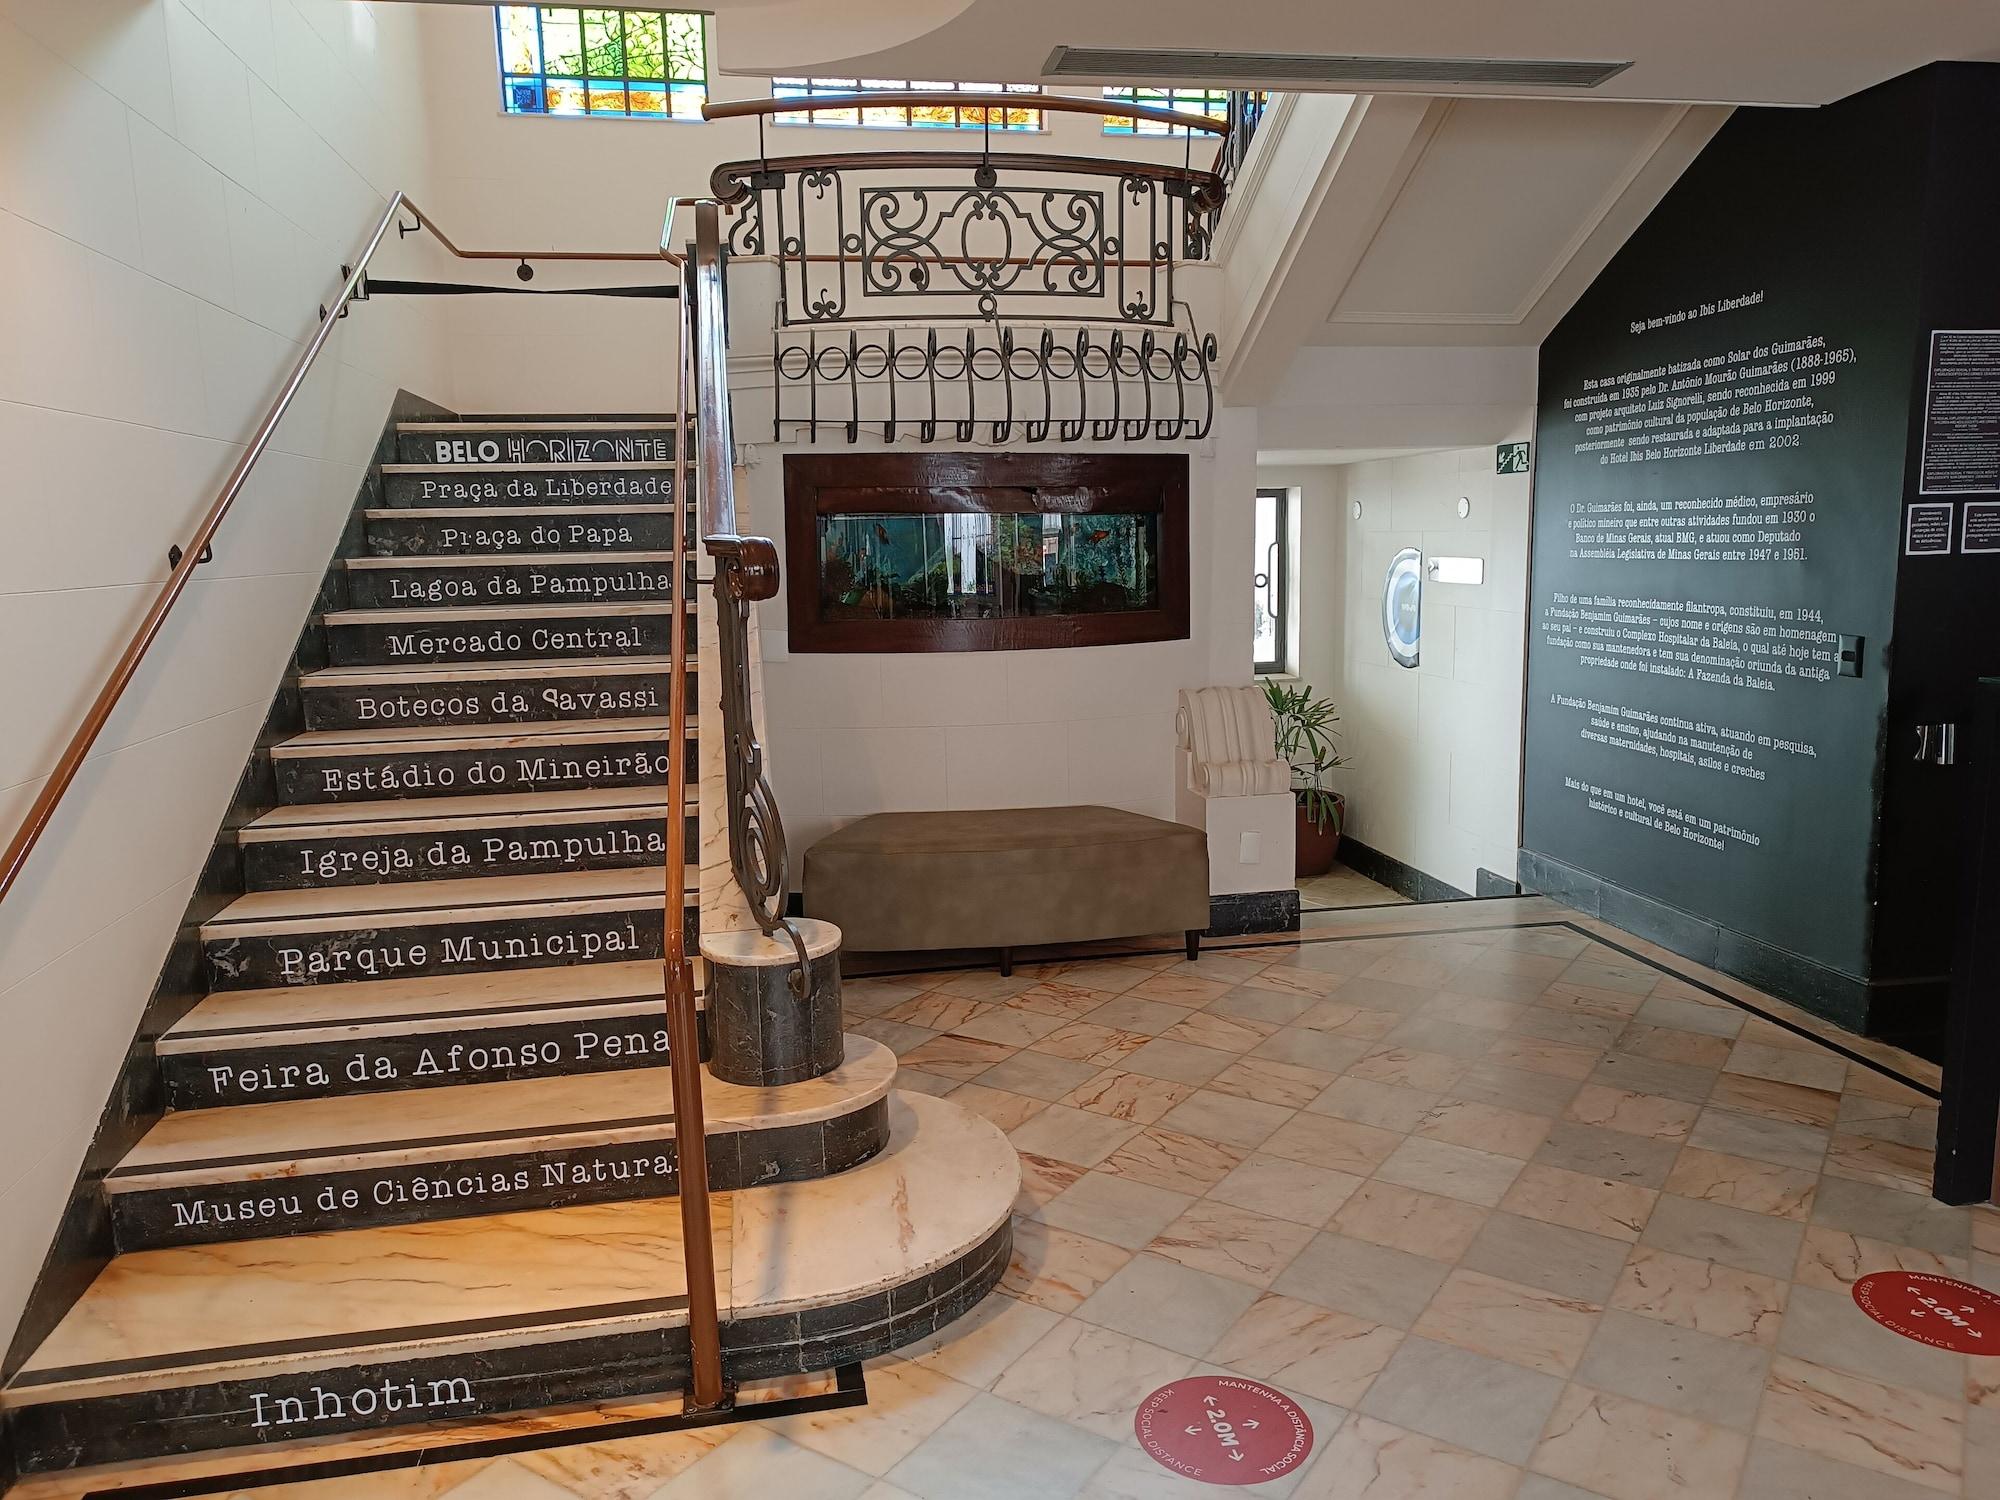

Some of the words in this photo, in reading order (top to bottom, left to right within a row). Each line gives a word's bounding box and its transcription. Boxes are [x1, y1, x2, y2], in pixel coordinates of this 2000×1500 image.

[1630, 320, 1645, 334] Seja
[1647, 310, 1686, 329] bem-vindo
[1687, 309, 1697, 319] ao
[1699, 303, 1715, 316] Ibis
[1717, 290, 1763, 312] Liberdade!
[1583, 379, 1598, 390] Esta
[1599, 377, 1615, 387] casa
[1616, 366, 1666, 384] originalmente
[1668, 358, 1701, 374] batizada
[1703, 355, 1725, 367] como
[1727, 350, 1751, 363] Solar
[1752, 346, 1768, 358] dos
[1771, 336, 1825, 355] Guimarães,
[1609, 392, 1619, 401] em
[1621, 386, 1639, 399] 1935
[1641, 384, 1656, 398] pelo
[1670, 376, 1702, 390] Antônio
[1704, 369, 1737, 385] Mourão
[1739, 361, 1788, 379] Guimarães
[1790, 348, 1856, 372] (1888-1965),
[1574, 413, 1588, 421] com
[1589, 407, 1612, 422] projeto
[1647, 399, 1664, 411] Luiz
[1666, 392, 1704, 409] Signorelli,
[1707, 388, 1732, 402] sendo
[1734, 379, 1789, 397] reconhecida
[1792, 378, 1806, 389] em
[1810, 371, 1835, 386] 1999
[1586, 426, 1603, 435] como
[1644, 413, 1673, 427] cultural
[1675, 412, 1685, 423] da
[1687, 406, 1727, 424] população
[1729, 404, 1740, 416] de
[1742, 401, 1762, 414] Belo
[1764, 395, 1813, 412] Horizonte,
[436, 441, 499, 462] BELO
[508, 437, 667, 463] HORIZONTE
[1600, 454, 1608, 464] do
[1610, 451, 1628, 463] Hotel
[1629, 450, 1643, 461] Ibis
[1645, 448, 1661, 460] Belo
[1663, 445, 1701, 458] Horizonte
[1703, 439, 1746, 454] Liberdade
[1748, 440, 1765, 450] em
[421, 481, 497, 502] Praça
[507, 480, 537, 497] da
[546, 477, 671, 495] Liberdade
[1587, 501, 1622, 512] Guimarães
[1623, 501, 1634, 512] foi,
[1636, 500, 1658, 511] ainda,
[1660, 501, 1672, 510] um
[1674, 497, 1723, 509] reconhecido
[1725, 495, 1757, 508] médico,
[1760, 491, 1813, 507] empresário
[442, 529, 521, 549] Praça
[531, 526, 559, 544] do
[568, 525, 632, 546] Papa
[1575, 533, 1595, 542] Banco
[1596, 533, 1604, 542] de
[1605, 533, 1626, 542] Minas
[1627, 532, 1653, 544] Gerais,
[1654, 532, 1674, 543] atual
[1675, 532, 1696, 544] BMG,
[1699, 534, 1704, 542] e
[1705, 532, 1729, 542] atuou
[1732, 533, 1755, 542] como
[1757, 529, 1800, 544] Deputado
[390, 580, 476, 601] Lagoa
[488, 576, 521, 595] da
[530, 572, 671, 596] Pampulha
[389, 631, 520, 655] Mercado
[533, 627, 641, 649] Central
[1580, 655, 1618, 667] propriedade
[1620, 659, 1637, 670] onde
[1649, 662, 1685, 677] instalado:
[1687, 667, 1694, 678] A
[1696, 668, 1731, 684] Fazenda
[1732, 674, 1743, 686] da
[1745, 675, 1775, 690] Baleia.
[356, 696, 478, 719] Botecos
[492, 692, 528, 713] da
[1550, 694, 1555, 703] A
[1620, 706, 1658, 723] Guimarães
[1659, 716, 1694, 730] continua
[1695, 722, 1718, 737] ativa,
[1720, 727, 1755, 742] atuando
[1757, 735, 1771, 746] em
[1773, 738, 1816, 758] pesquisa,
[1642, 727, 1676, 743] ajudando
[1678, 736, 1688, 745] na
[1690, 738, 1740, 757] manutenção
[1742, 747, 1752, 759] de
[1580, 728, 1607, 743] diversas
[1608, 736, 1658, 757] maternidades,
[1659, 745, 1696, 765] hospitais,
[1698, 757, 1722, 770] asilos
[1724, 763, 1729, 771] e
[1731, 764, 1765, 780] creches
[322, 765, 454, 791] Estádio
[468, 762, 505, 784] do
[517, 753, 669, 781] Mineirão
[1624, 811, 1652, 826] cultural
[1653, 818, 1662, 829] de
[1664, 821, 1680, 835] Belo
[1682, 826, 1724, 850] Horizonte!
[301, 849, 413, 877] Igreja
[428, 842, 470, 865] da
[482, 831, 665, 862] Pampulha
[279, 945, 426, 974] Parque
[441, 925, 640, 963] Municipal
[208, 1064, 329, 1093] Feira
[346, 1054, 397, 1081] da
[413, 1042, 559, 1075] Afonso
[574, 1031, 670, 1059] Pena
[172, 1197, 302, 1226] Museu
[318, 1187, 358, 1210] de
[373, 1167, 530, 1205] Ciências
[541, 1156, 678, 1186] Natura
[1908, 1274, 1981, 1294] MANTENHA
[1885, 1320, 1956, 1348] DISTANCE
[249, 1376, 476, 1428] Inhotim
[1151, 1388, 1175, 1408] KEEP
[1218, 1380, 1281, 1406] MANTENHA
[1142, 1408, 1154, 1438] SOCIAL
[1206, 1409, 1240, 1447] 2.0M
[1287, 1411, 1306, 1452] DISTÂNCIA
[1148, 1441, 1203, 1476] DISTANCE
[1259, 1452, 1297, 1475] SOCIAL
